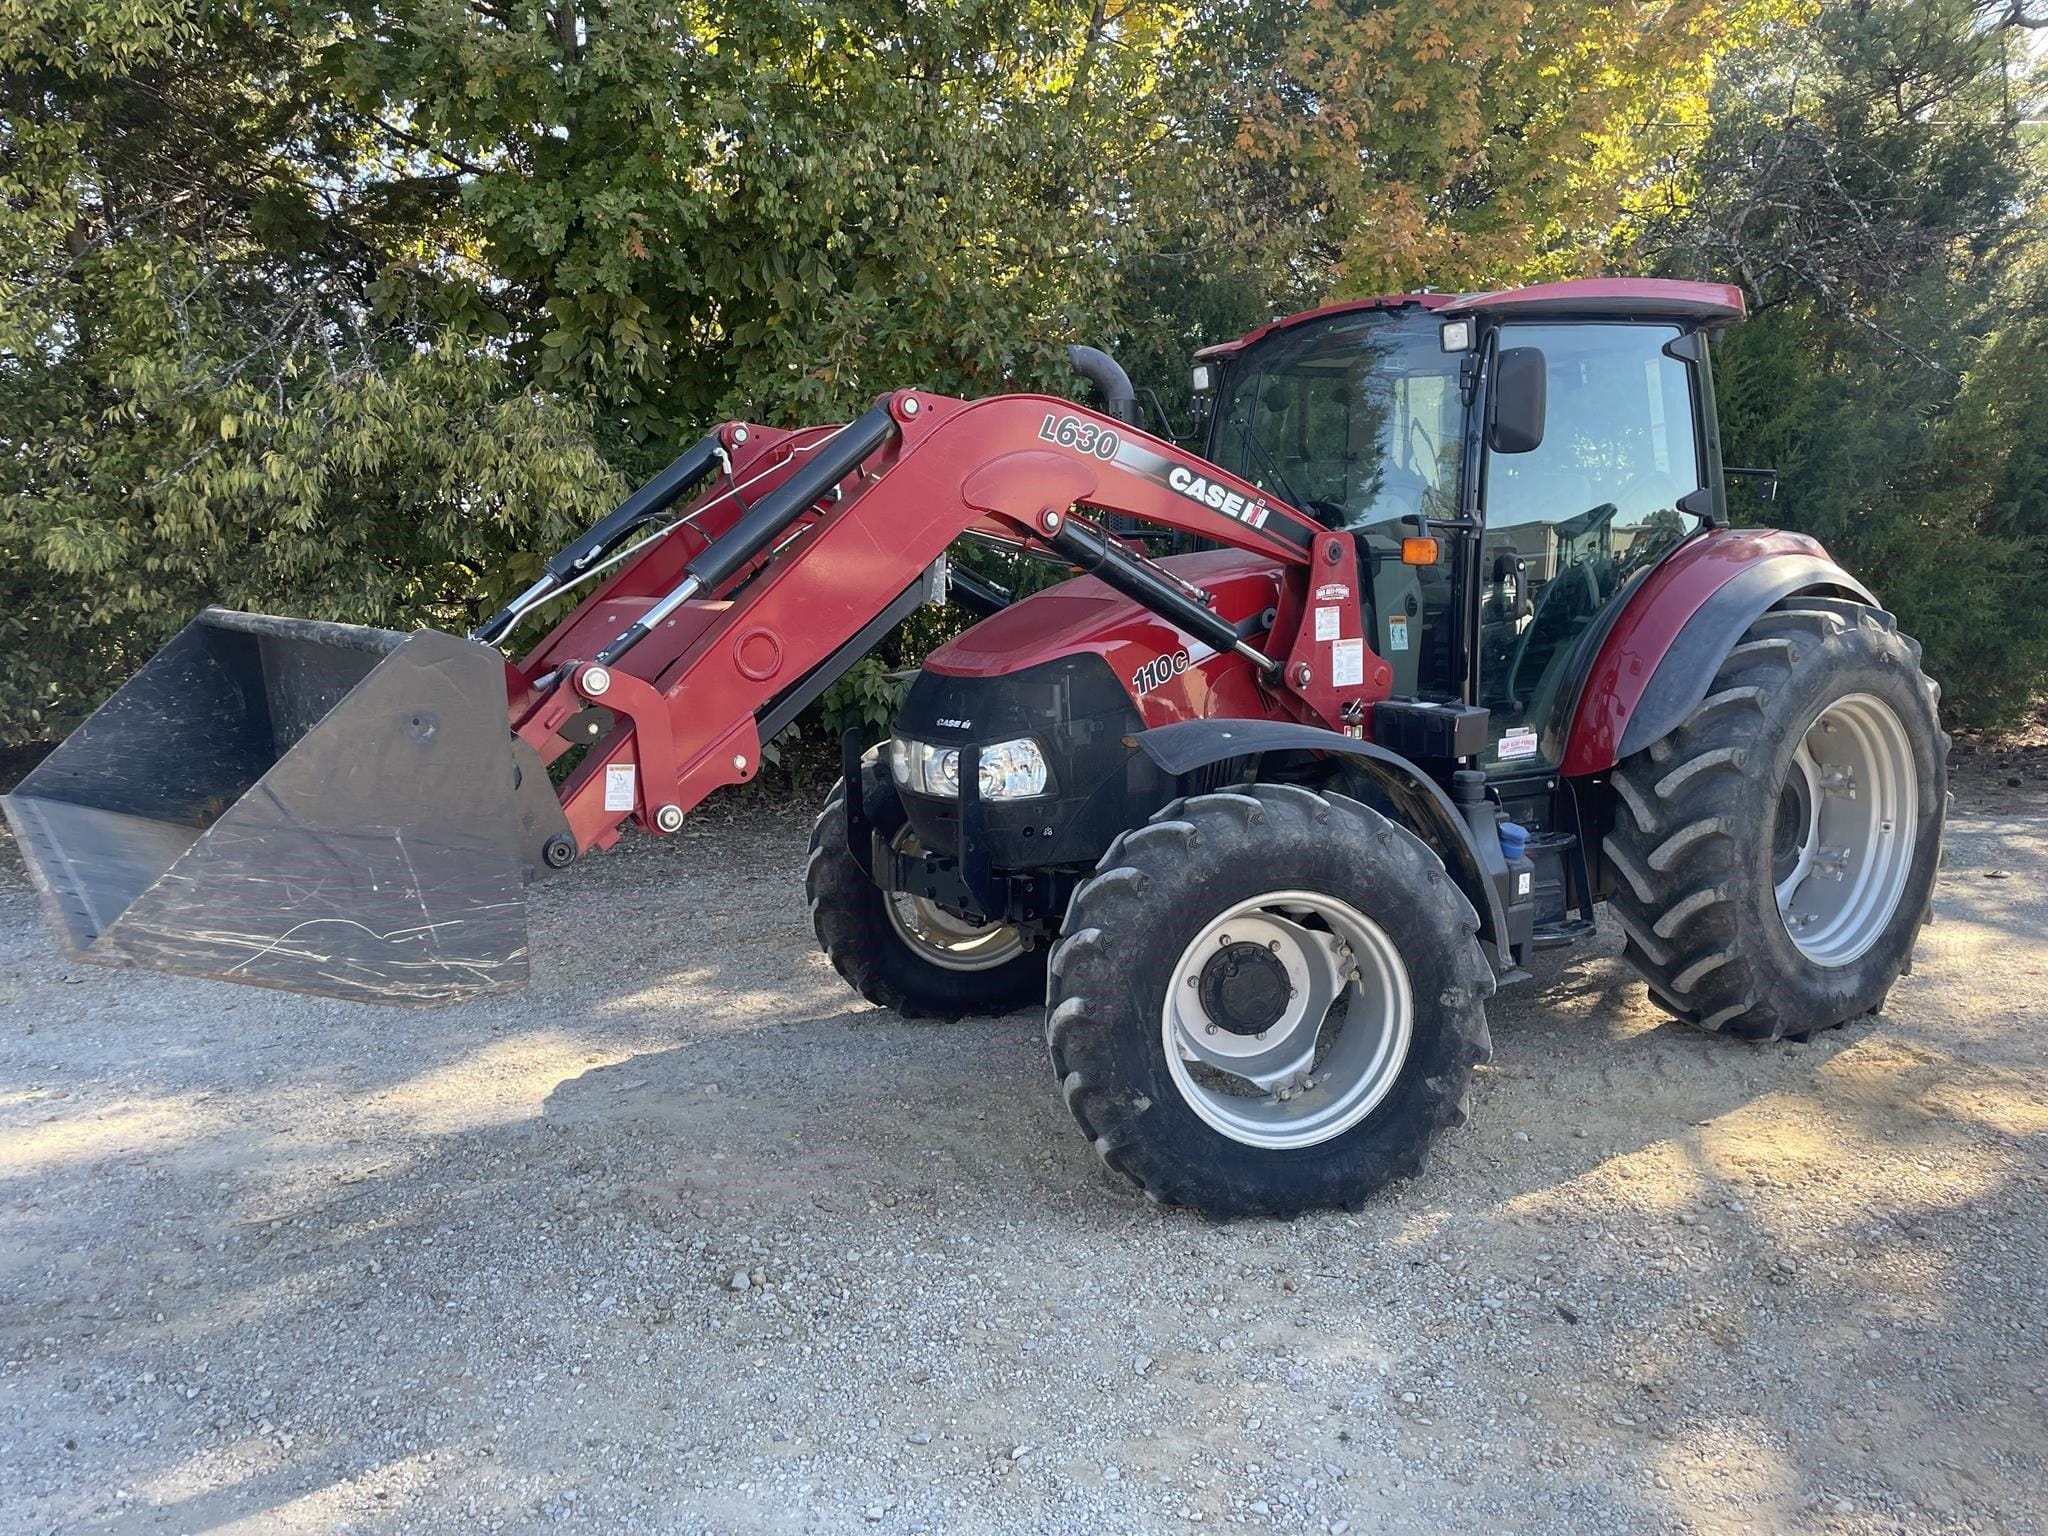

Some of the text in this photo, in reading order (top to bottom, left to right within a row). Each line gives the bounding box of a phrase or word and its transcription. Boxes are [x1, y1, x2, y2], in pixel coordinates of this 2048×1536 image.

[1038, 414, 1120, 462] L630
[1168, 467, 1244, 518] CASE
[1132, 650, 1188, 696] 110C
[936, 718, 961, 728] CASE
